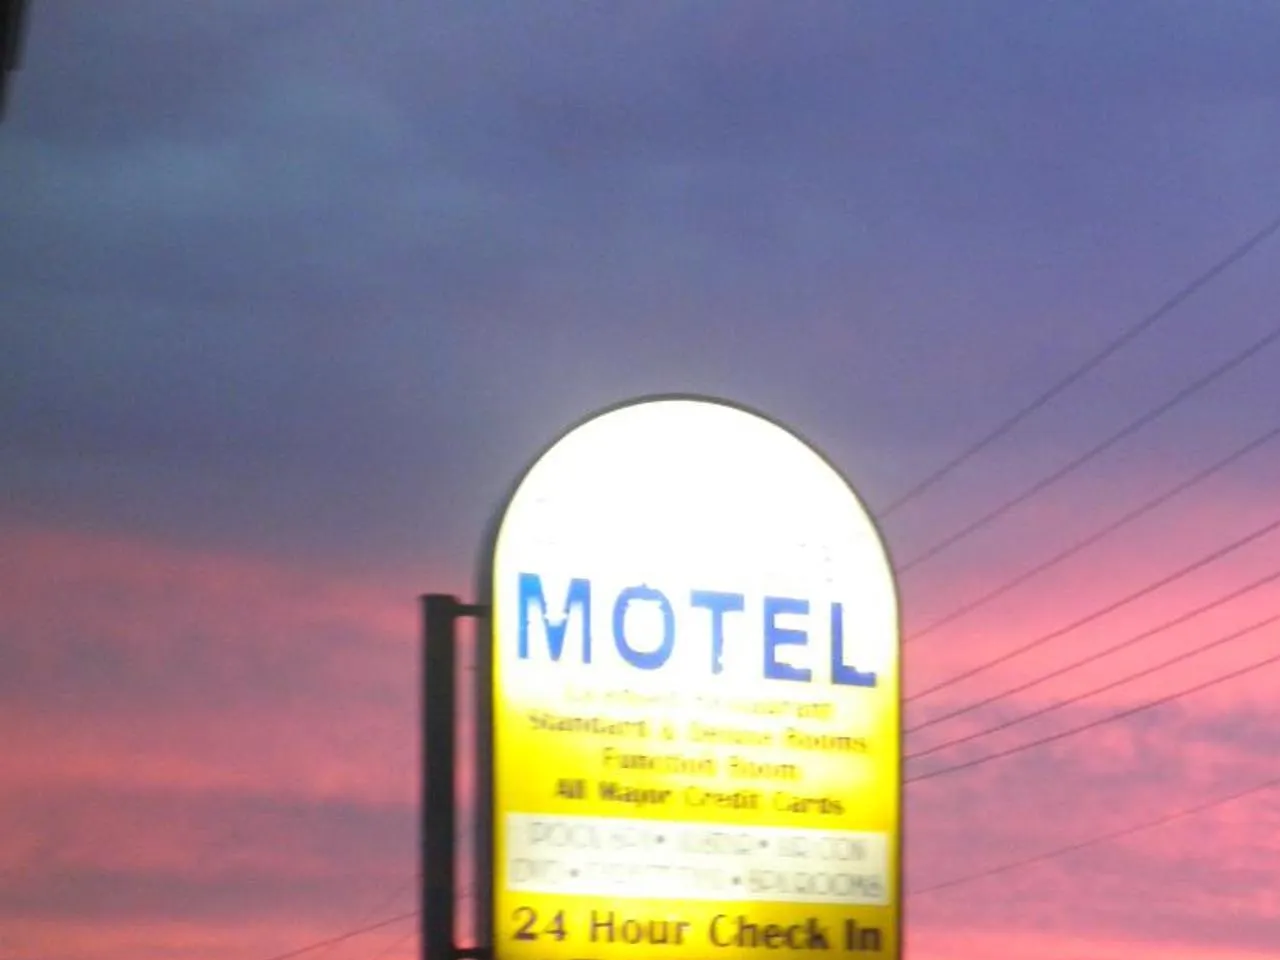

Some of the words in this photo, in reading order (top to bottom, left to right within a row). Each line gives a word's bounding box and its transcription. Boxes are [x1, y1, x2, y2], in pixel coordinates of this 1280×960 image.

[517, 571, 877, 687] MOTEL
[554, 777, 588, 801] All
[599, 779, 674, 808] Major
[684, 786, 761, 811] Credit
[773, 790, 846, 817] Cards
[511, 905, 568, 943] 24
[589, 909, 691, 946] Hour
[708, 912, 830, 951] Check
[844, 917, 882, 952] In
